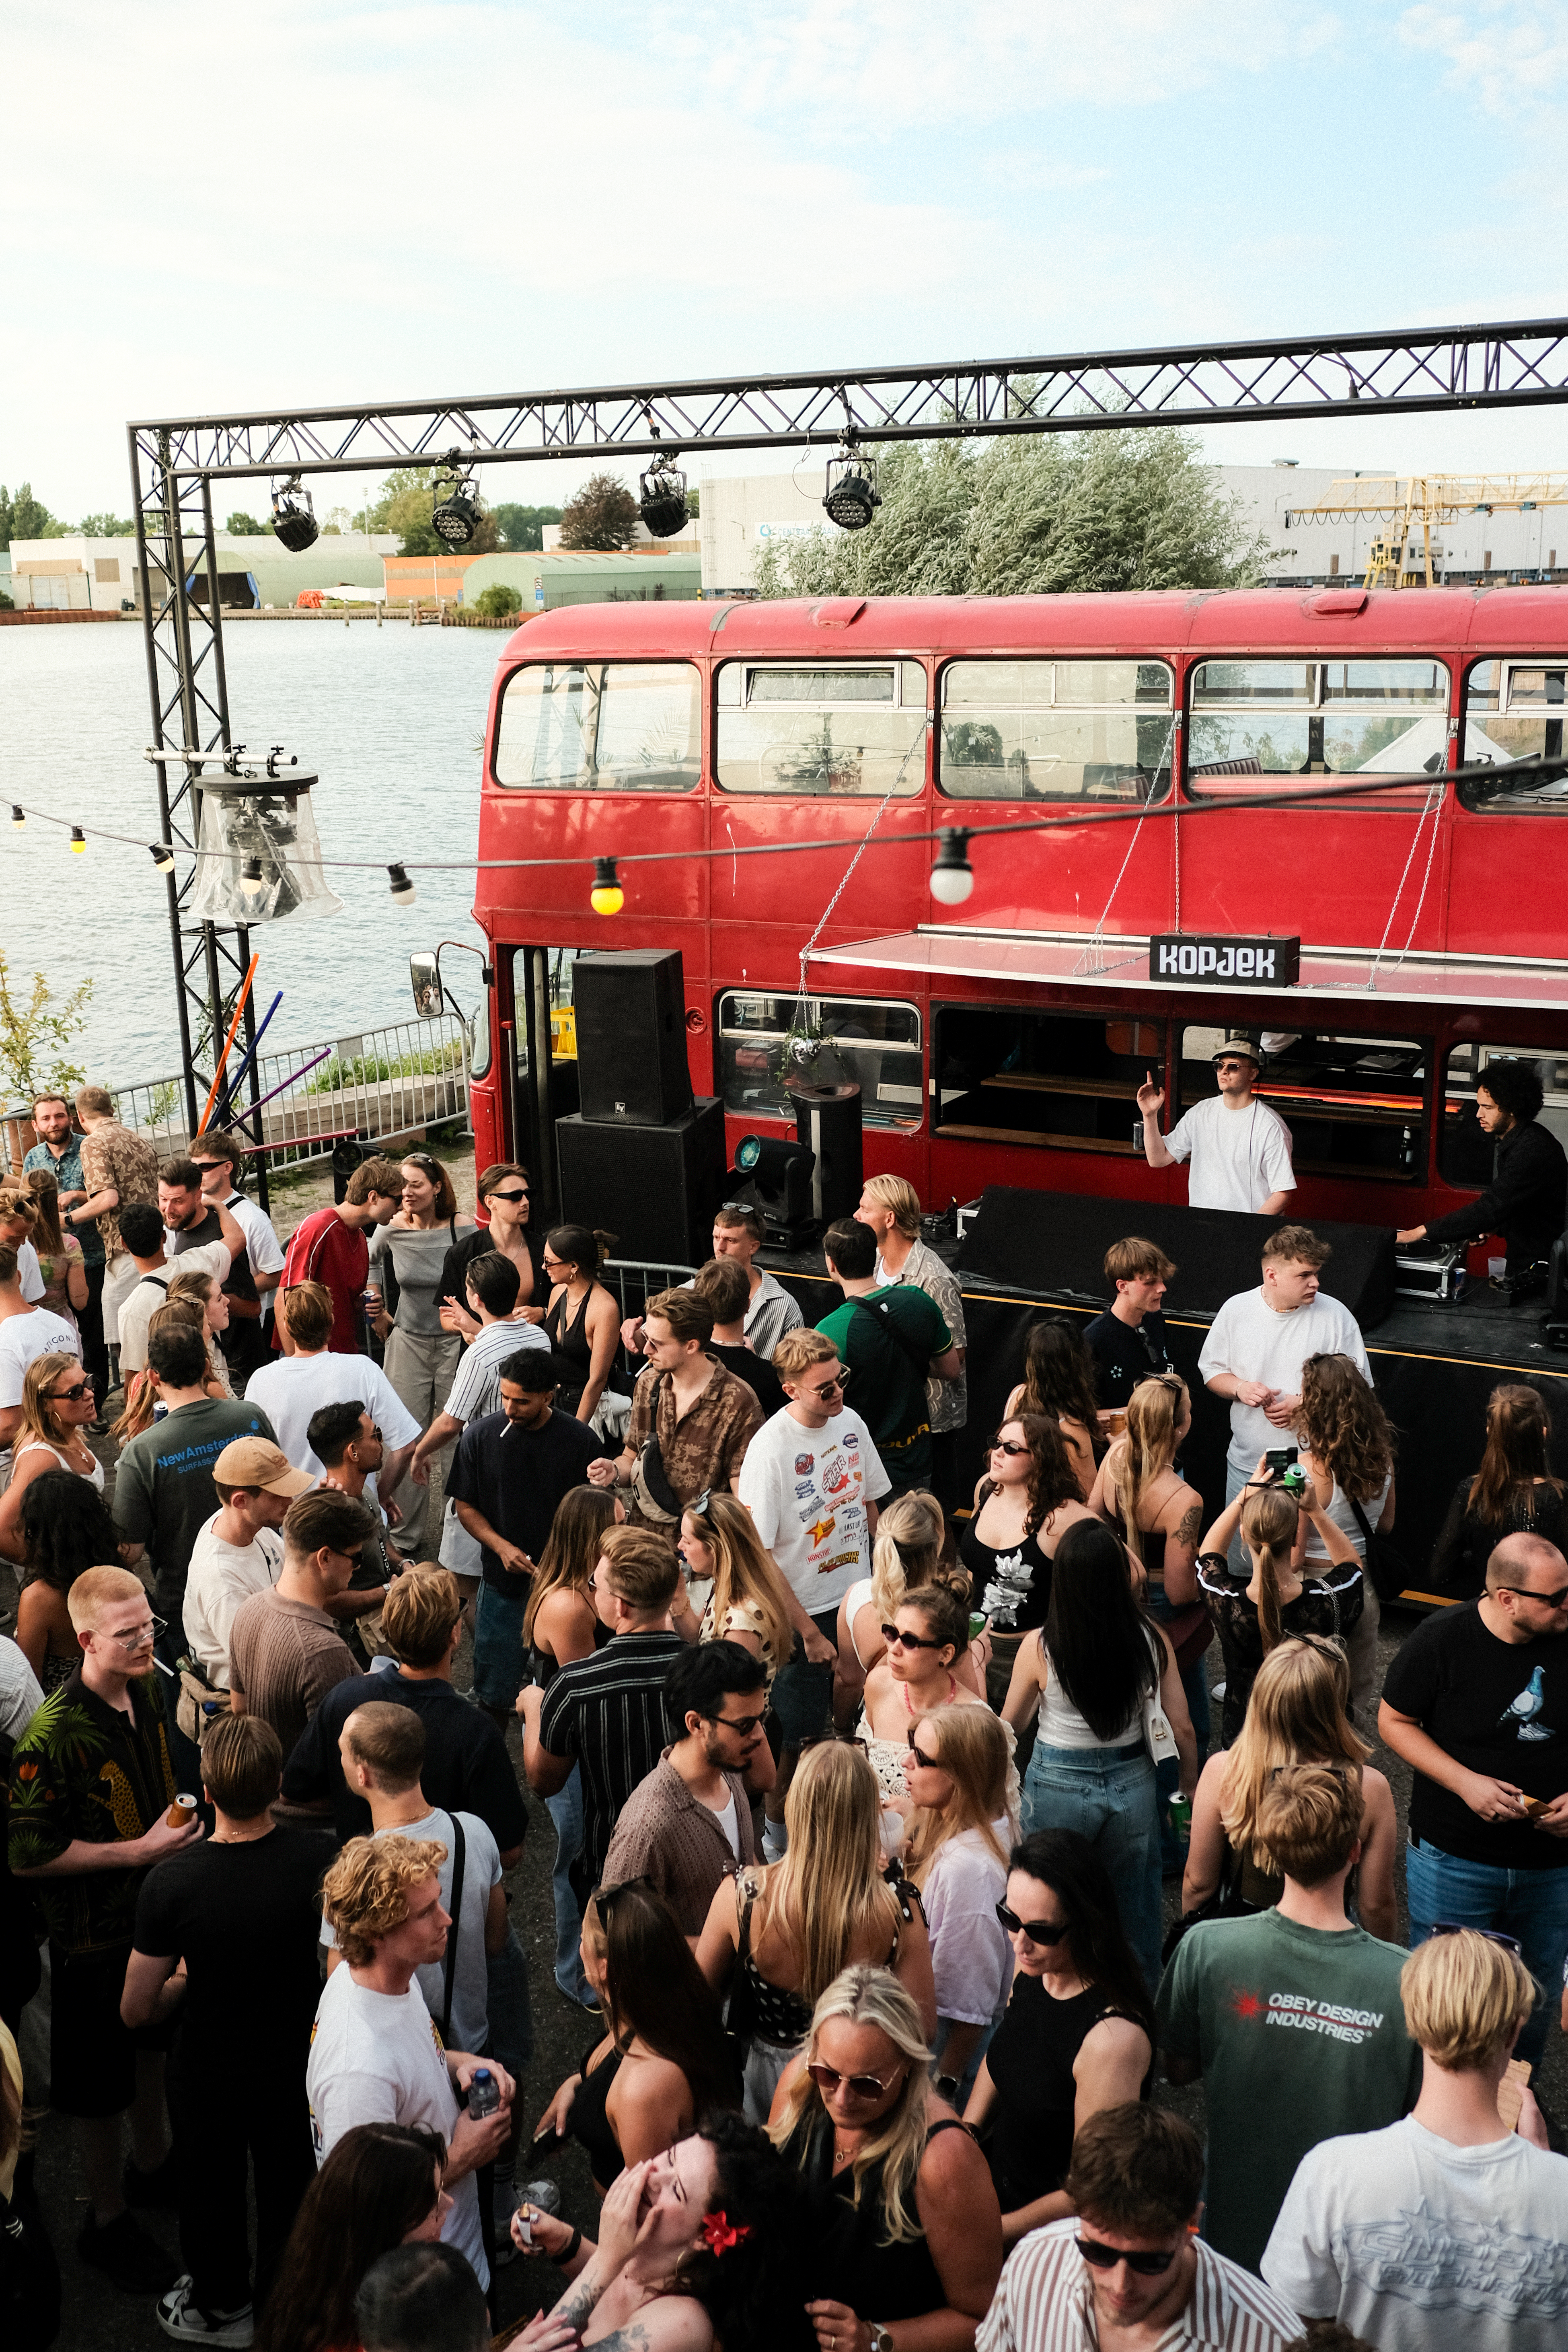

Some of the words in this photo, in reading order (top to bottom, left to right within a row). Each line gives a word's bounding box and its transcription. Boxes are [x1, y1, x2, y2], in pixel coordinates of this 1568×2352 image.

[822, 1455, 847, 1493] STAR
[798, 1485, 812, 1493] WASTE
[845, 1522, 854, 1531] LAST
[808, 1548, 830, 1563] NONSTOP
[1268, 1992, 1317, 2013] OBEY
[1317, 2001, 1384, 2028] DESIGN
[1266, 2010, 1365, 2044] INDUSTRIES
